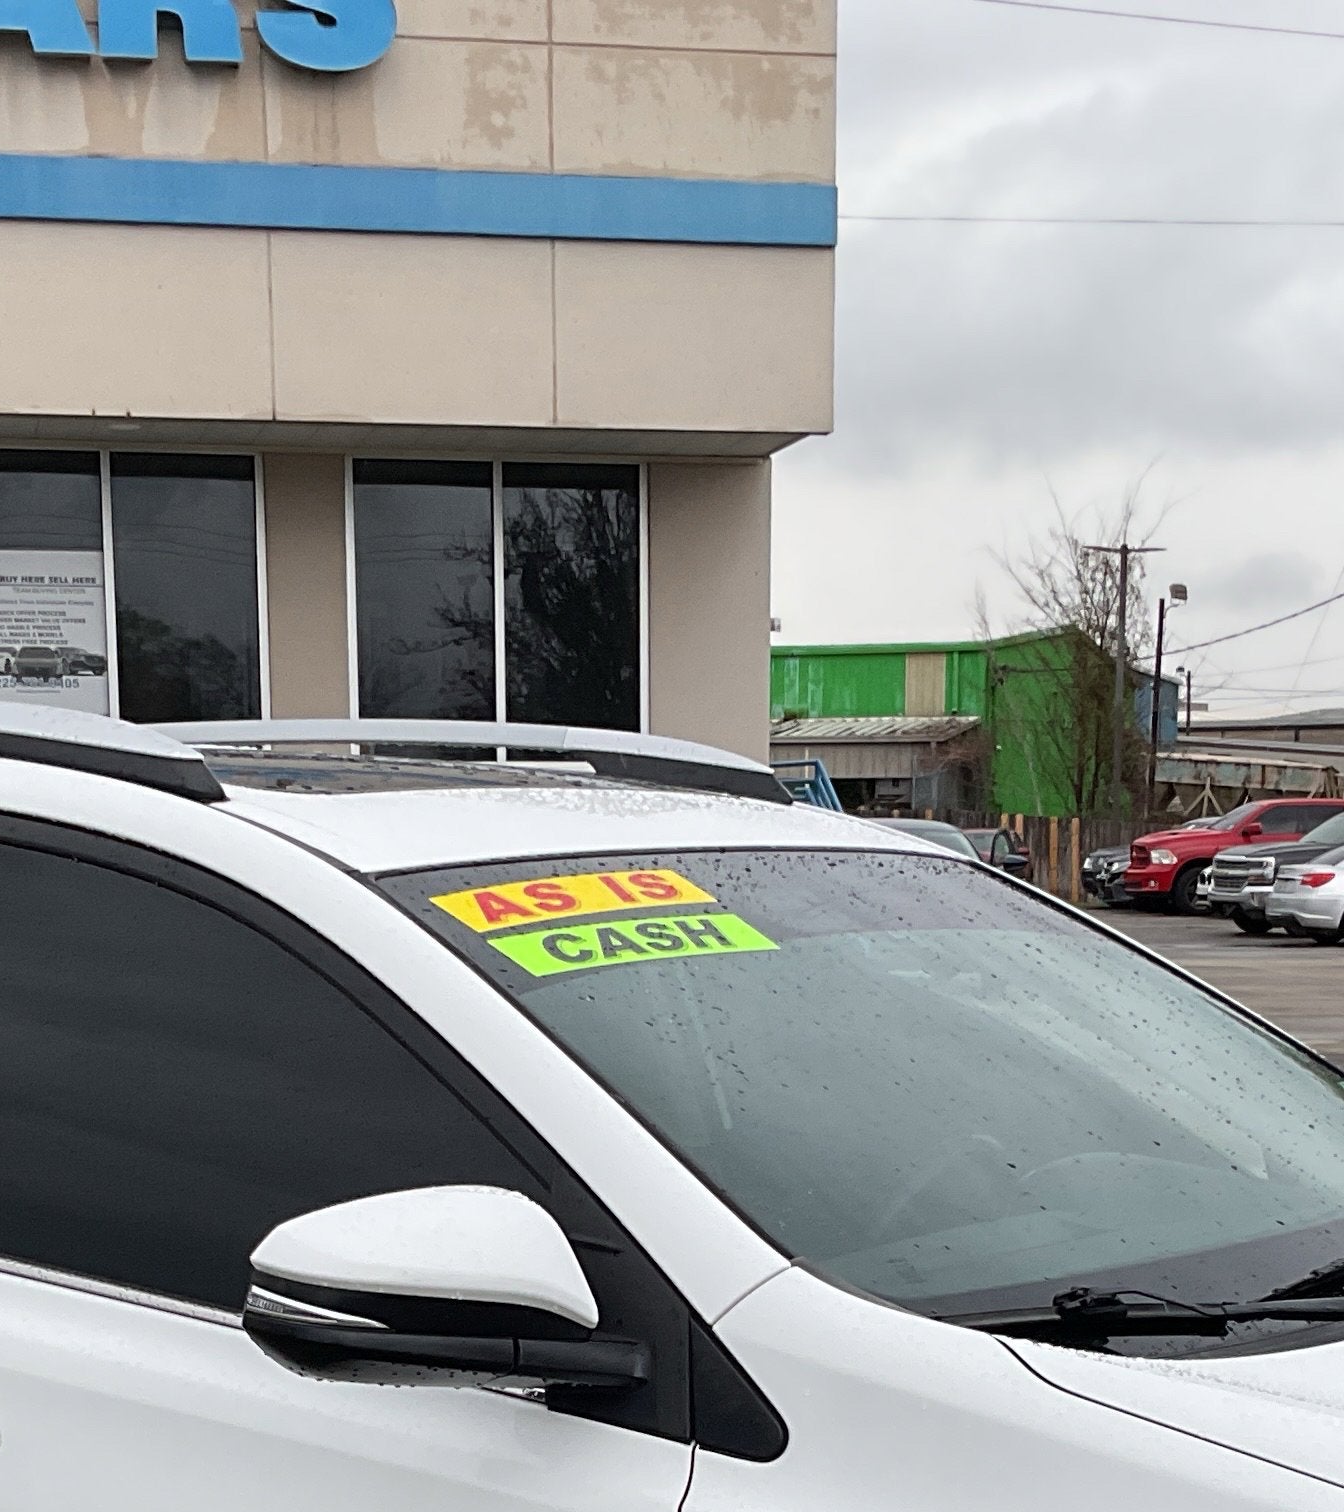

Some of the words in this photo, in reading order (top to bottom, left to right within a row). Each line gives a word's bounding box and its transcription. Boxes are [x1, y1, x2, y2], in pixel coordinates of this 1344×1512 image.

[0, 575, 18, 583] BUY
[21, 576, 45, 584] HERE
[472, 883, 578, 925] AS
[598, 873, 683, 904] IS
[542, 919, 736, 964] CASH
